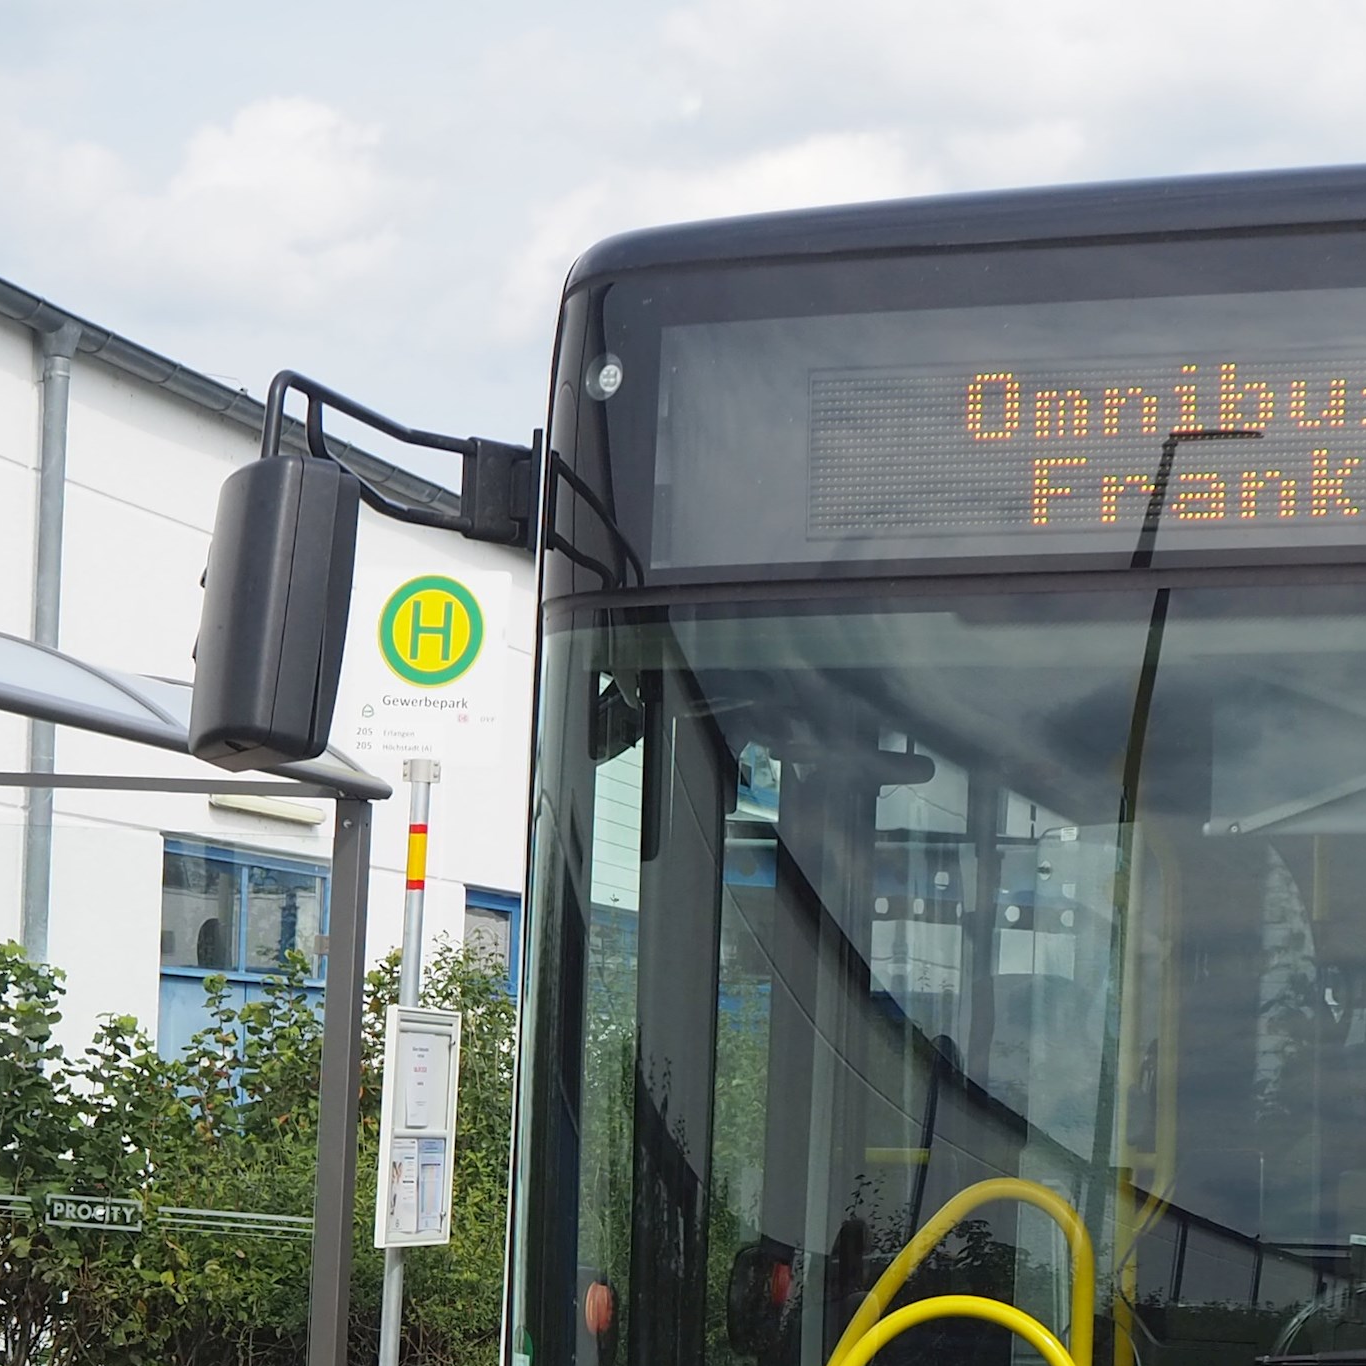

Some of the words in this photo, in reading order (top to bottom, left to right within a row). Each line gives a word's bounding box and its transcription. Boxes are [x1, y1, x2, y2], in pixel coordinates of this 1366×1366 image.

[409, 599, 454, 661] H
[382, 694, 469, 711] Gewerbepark
[356, 727, 373, 736] 205
[383, 730, 415, 739] Erlangen
[356, 741, 372, 750] 205
[382, 743, 419, 752] Höchstadt
[53, 1202, 135, 1224] PROCITY
